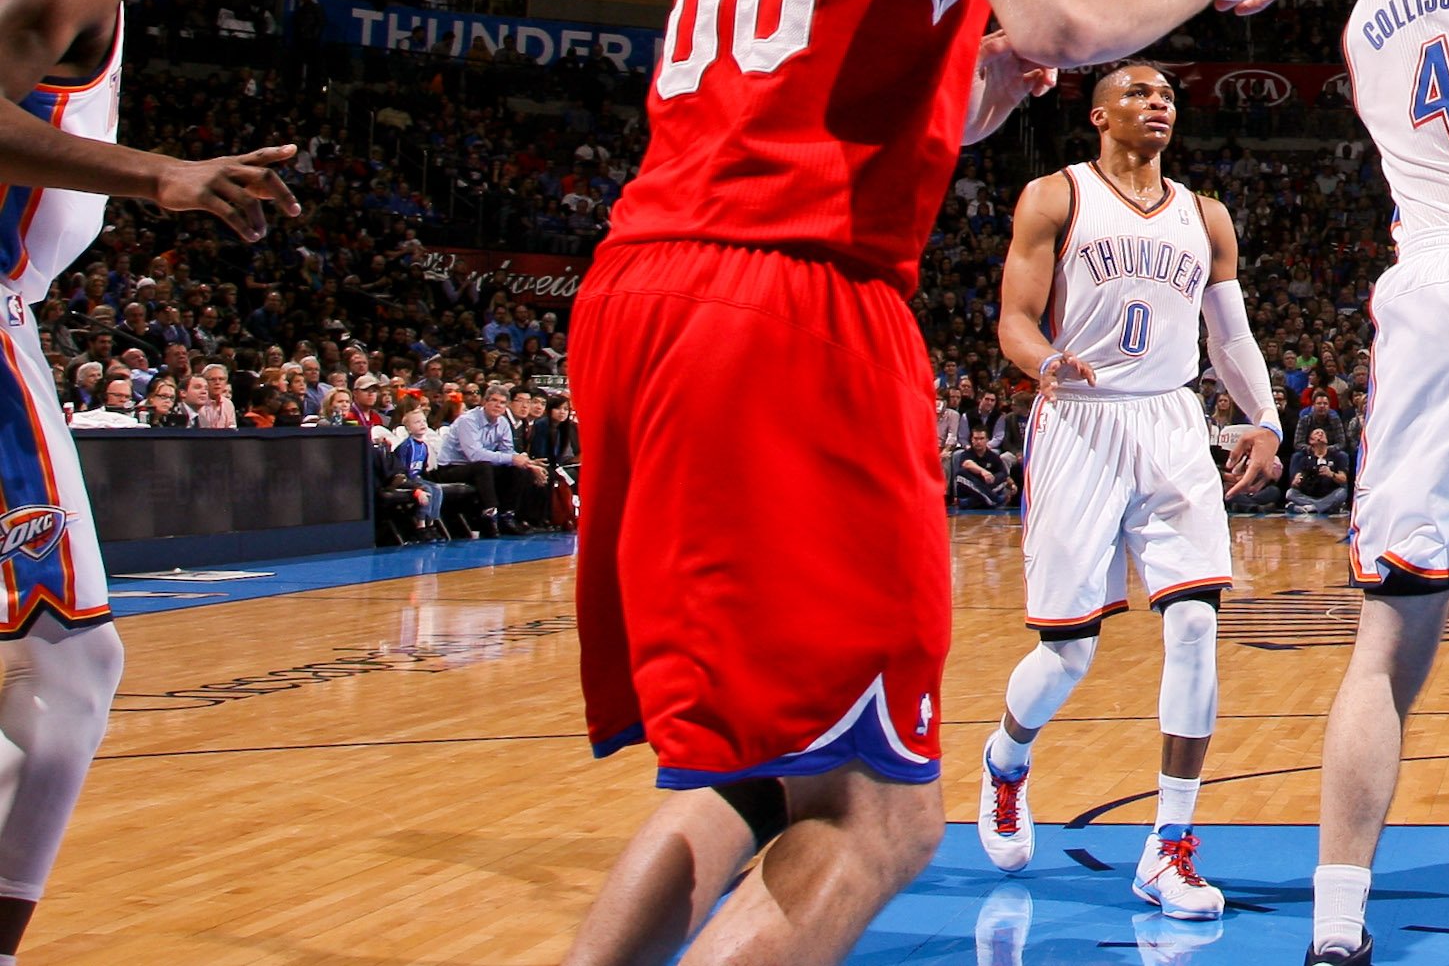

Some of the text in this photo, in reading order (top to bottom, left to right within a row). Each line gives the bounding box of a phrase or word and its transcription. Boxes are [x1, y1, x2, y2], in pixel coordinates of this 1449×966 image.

[1078, 235, 1204, 304] THUNDER
[1119, 299, 1152, 357] 0
[1, 513, 53, 555] OKC
